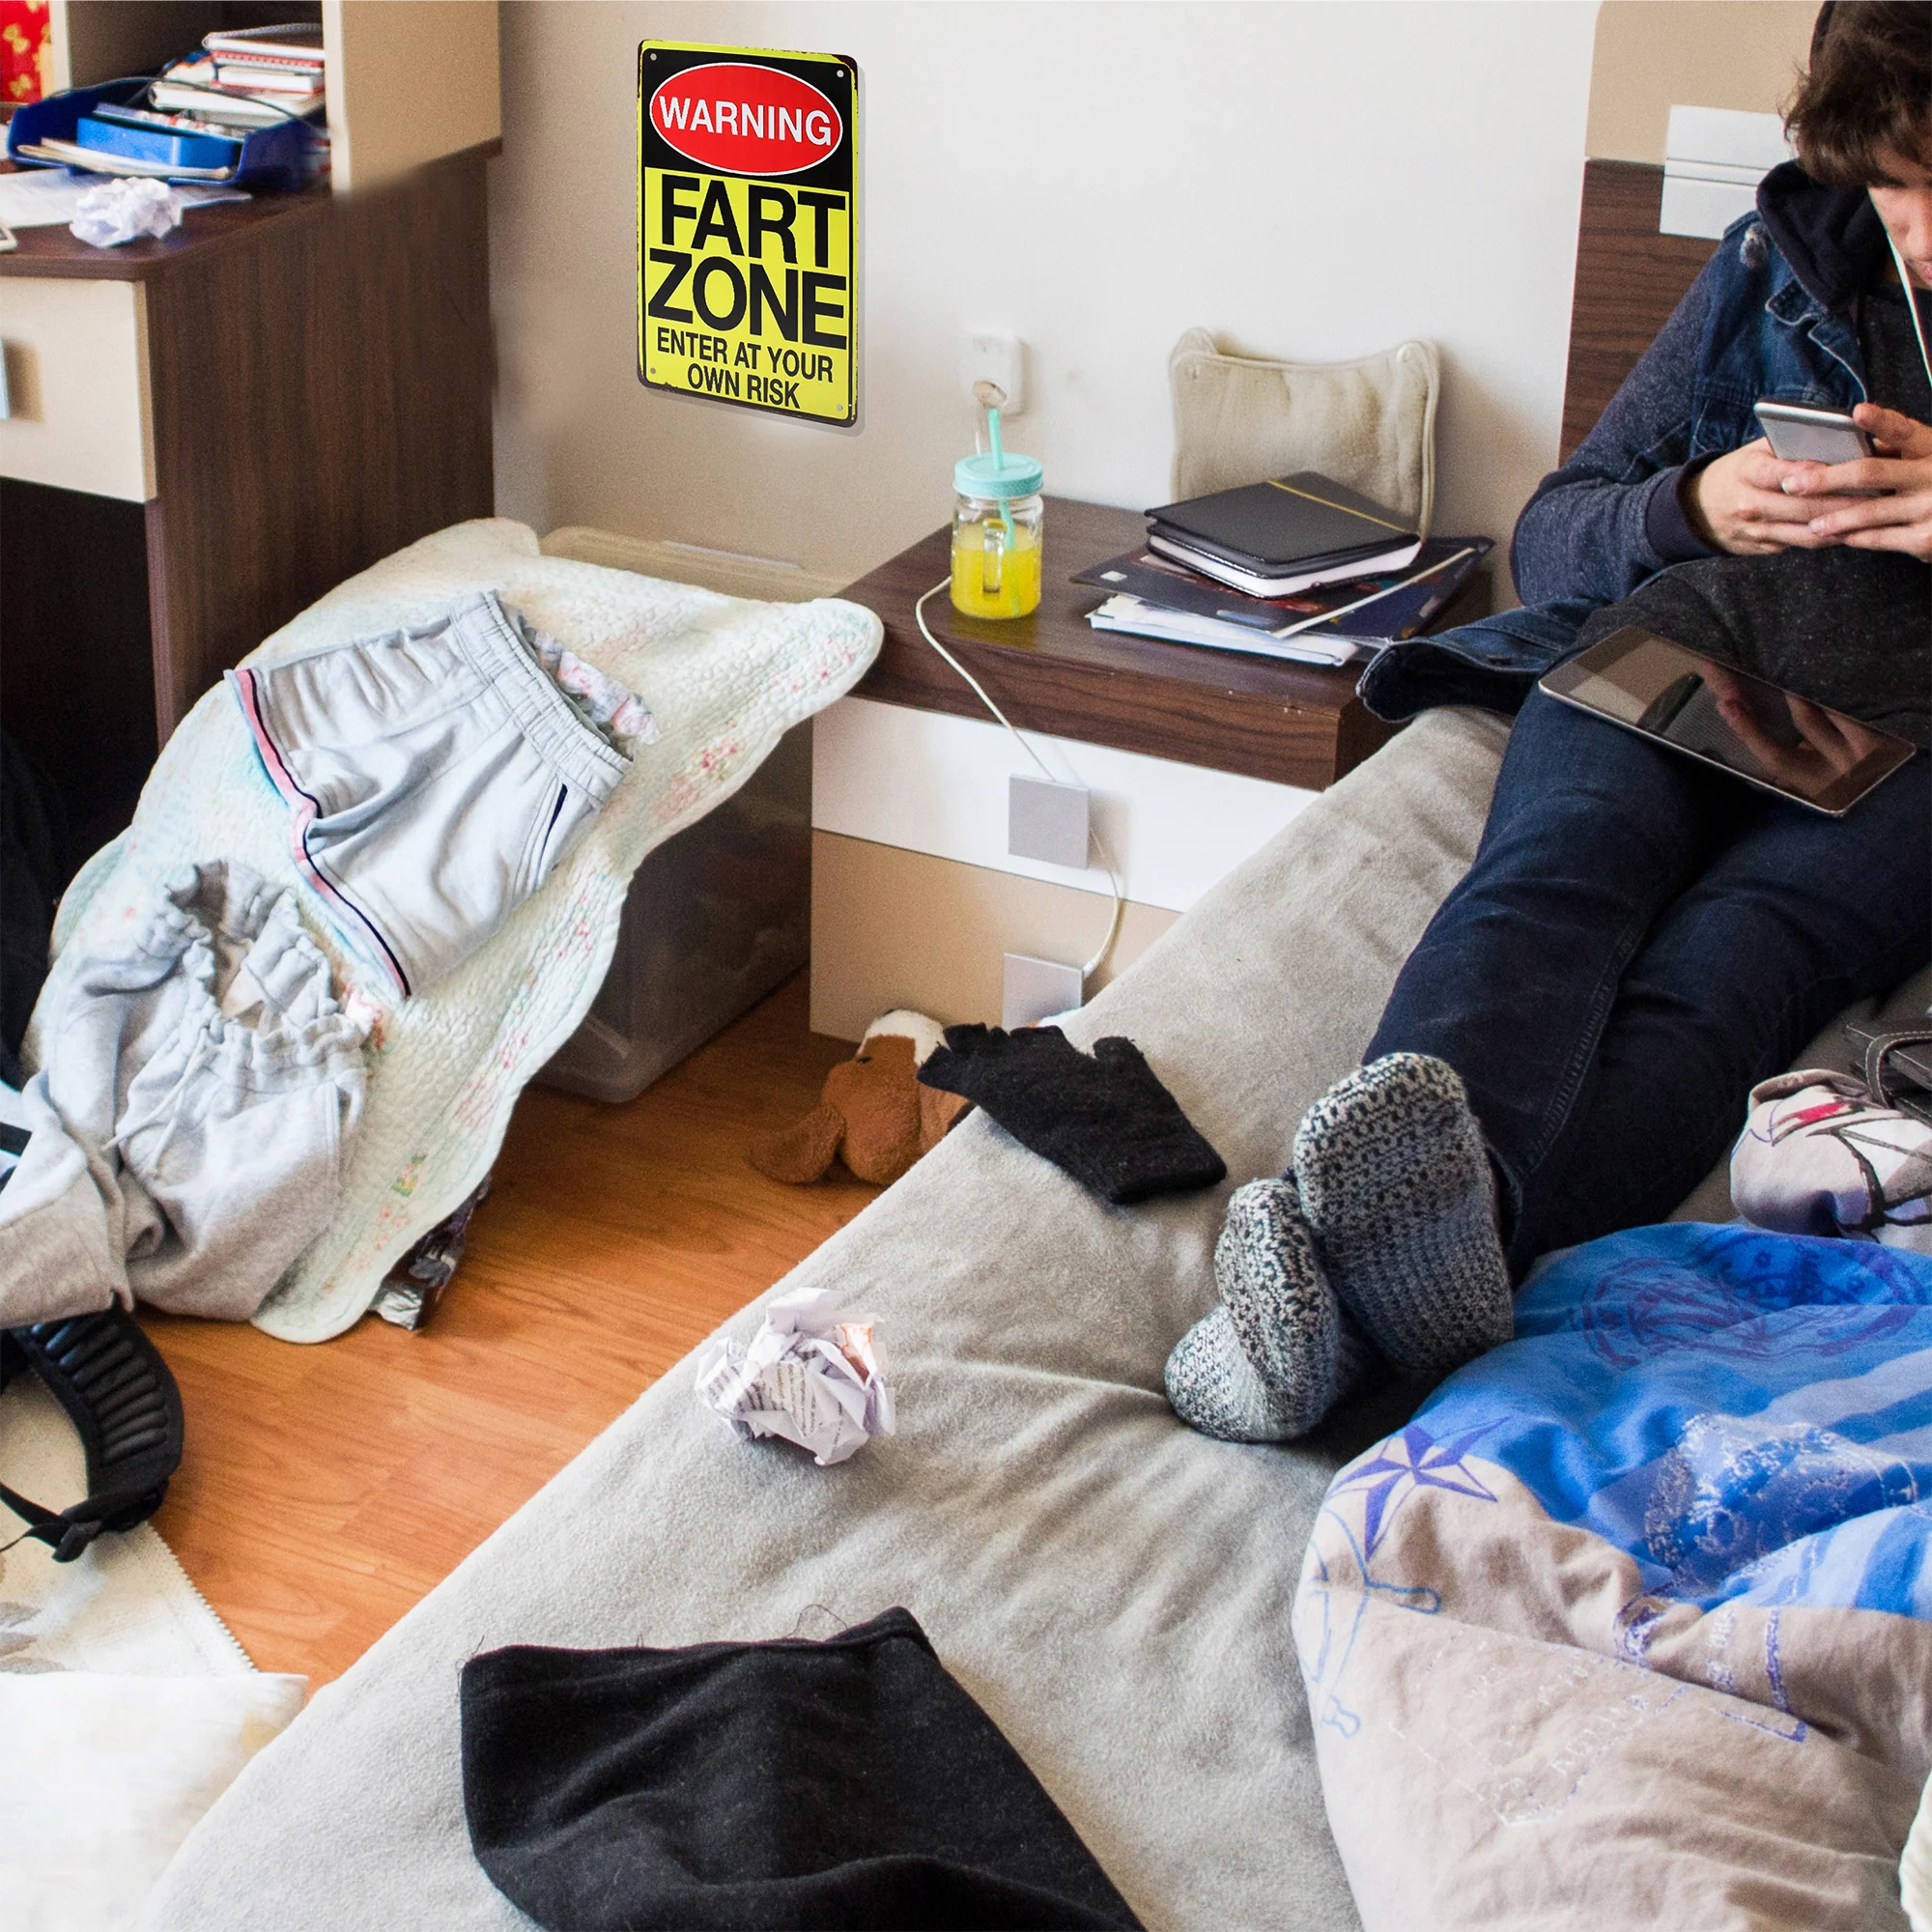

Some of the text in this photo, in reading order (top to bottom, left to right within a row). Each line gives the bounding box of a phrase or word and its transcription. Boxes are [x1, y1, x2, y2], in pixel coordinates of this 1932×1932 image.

[659, 96, 832, 146] WARNING
[663, 174, 845, 268] FART
[648, 248, 847, 350] ZONE
[657, 327, 834, 384] ENTER AT YOUR
[688, 363, 800, 409] OWN RISK
